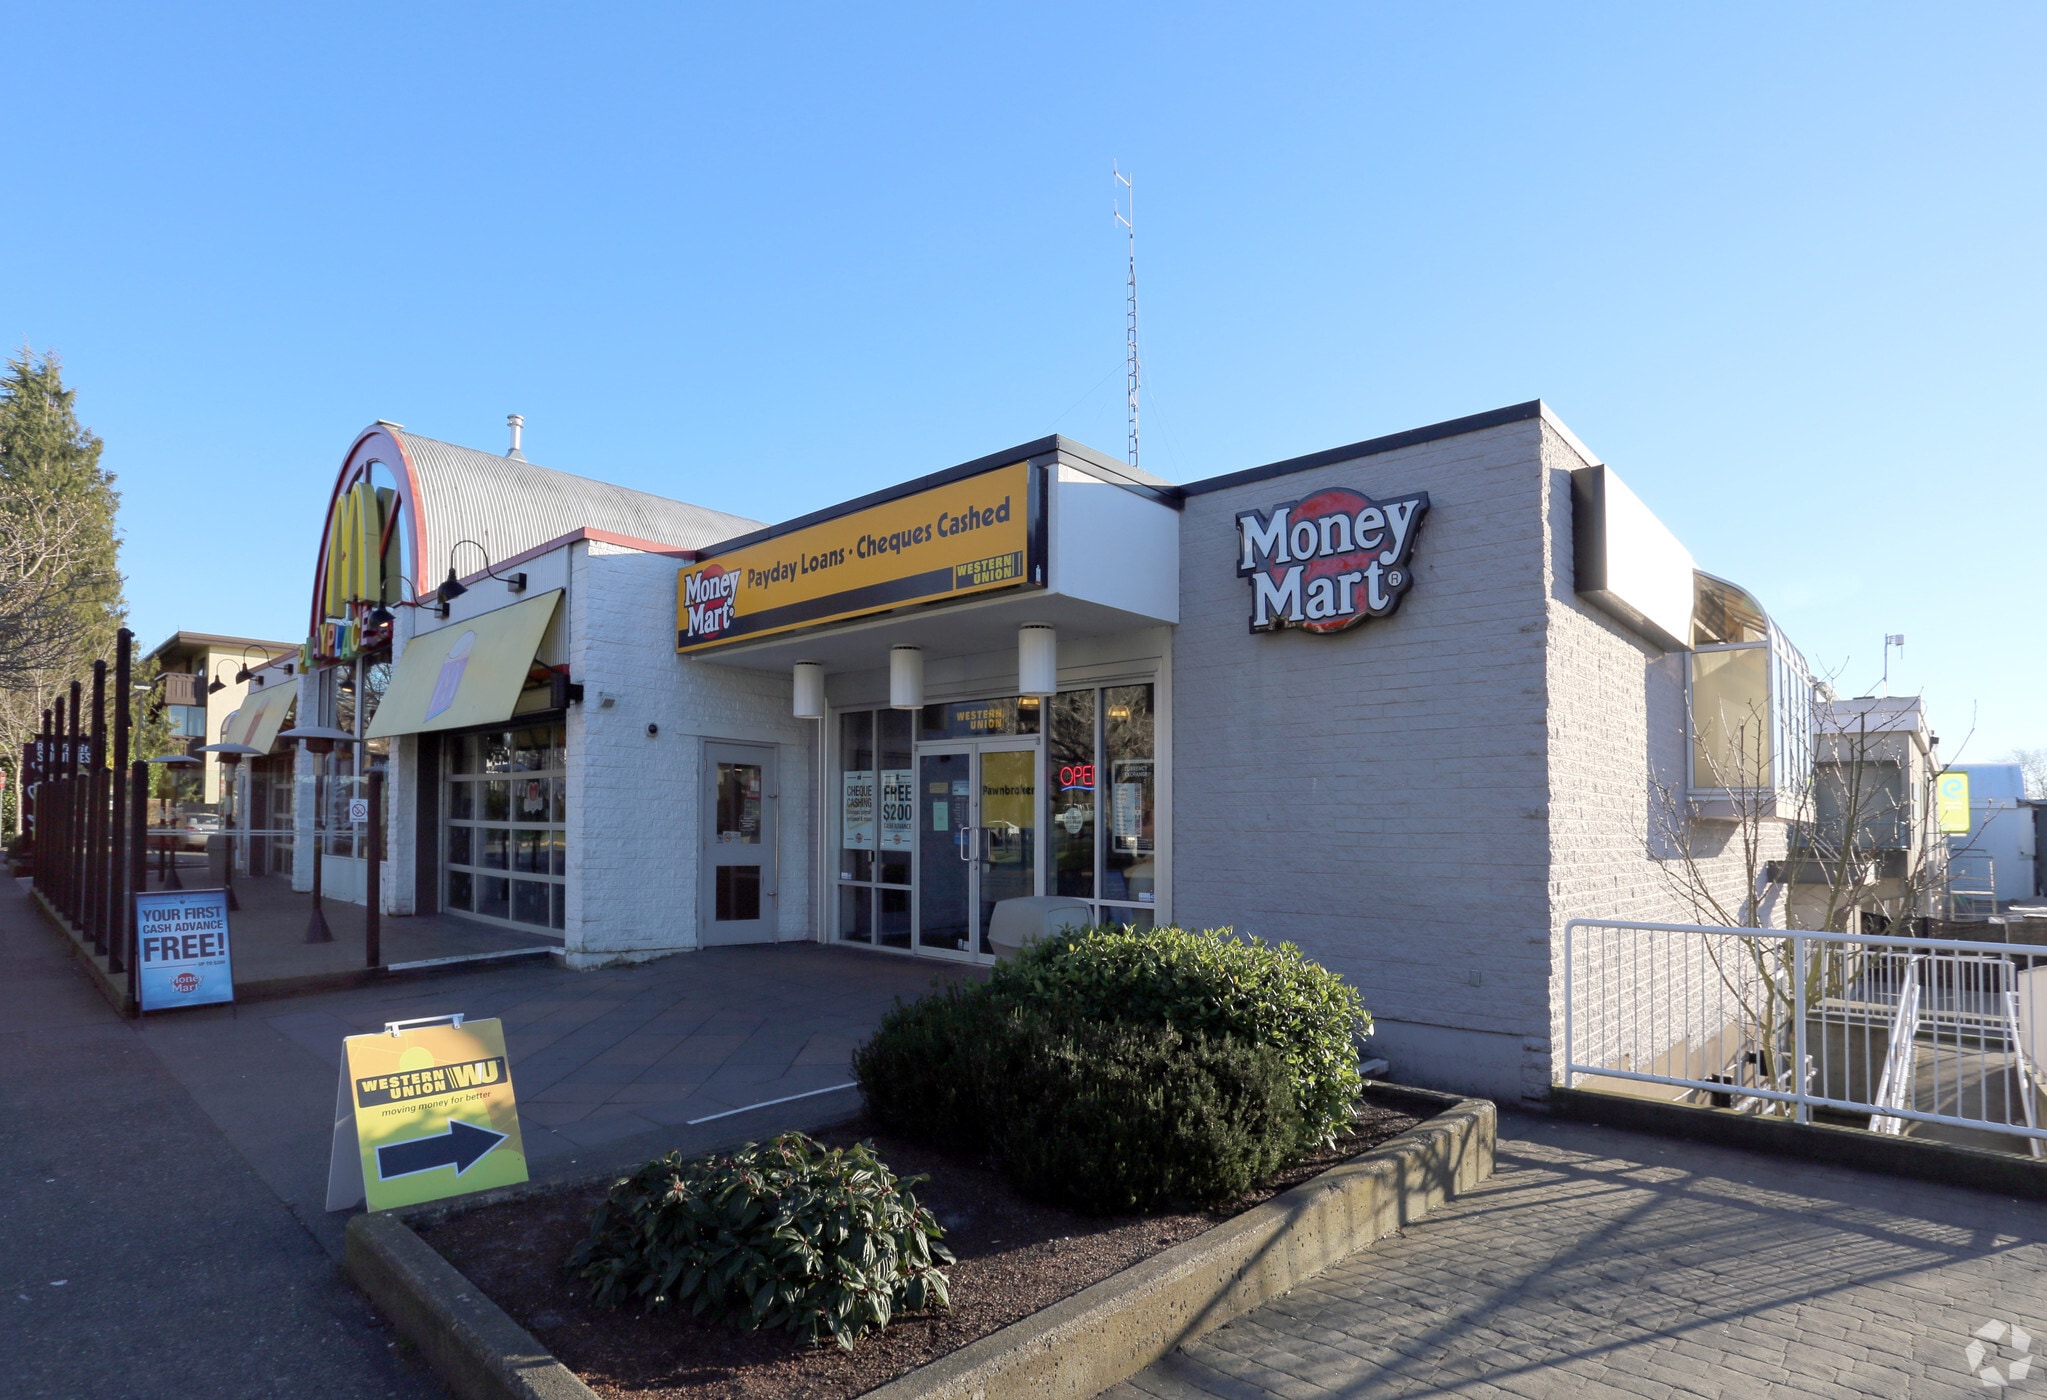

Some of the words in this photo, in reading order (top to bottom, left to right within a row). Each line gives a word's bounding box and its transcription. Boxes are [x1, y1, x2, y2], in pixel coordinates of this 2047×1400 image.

[748, 561, 797, 590] Payday
[801, 548, 844, 575] Loans
[857, 523, 931, 559] Cheques
[937, 495, 1010, 538] Cashed
[1240, 499, 1419, 570] Money
[957, 555, 1012, 577] WESTERN
[973, 568, 1012, 585] UNION
[685, 570, 741, 607] Money
[956, 708, 1002, 721] WESTERN
[970, 718, 1002, 730] UNION
[847, 785, 872, 797] CHEQUE
[884, 784, 912, 802] FREE
[982, 784, 1035, 796] Pawnbroker
[847, 797, 872, 808] CASHING
[883, 802, 912, 822] $200
[142, 908, 180, 922] YOUR
[184, 905, 222, 920] FIRST
[142, 923, 172, 934] CASH
[174, 920, 223, 932] ADVANCE
[143, 932, 225, 963] FREE!
[168, 974, 204, 985] Money
[172, 983, 199, 993] Mart
[361, 1068, 445, 1092] WESTERN
[390, 1079, 446, 1100] UNION
[381, 1104, 416, 1117] moving
[418, 1099, 449, 1111] money
[450, 1096, 463, 1104] for
[465, 1090, 491, 1102] better
